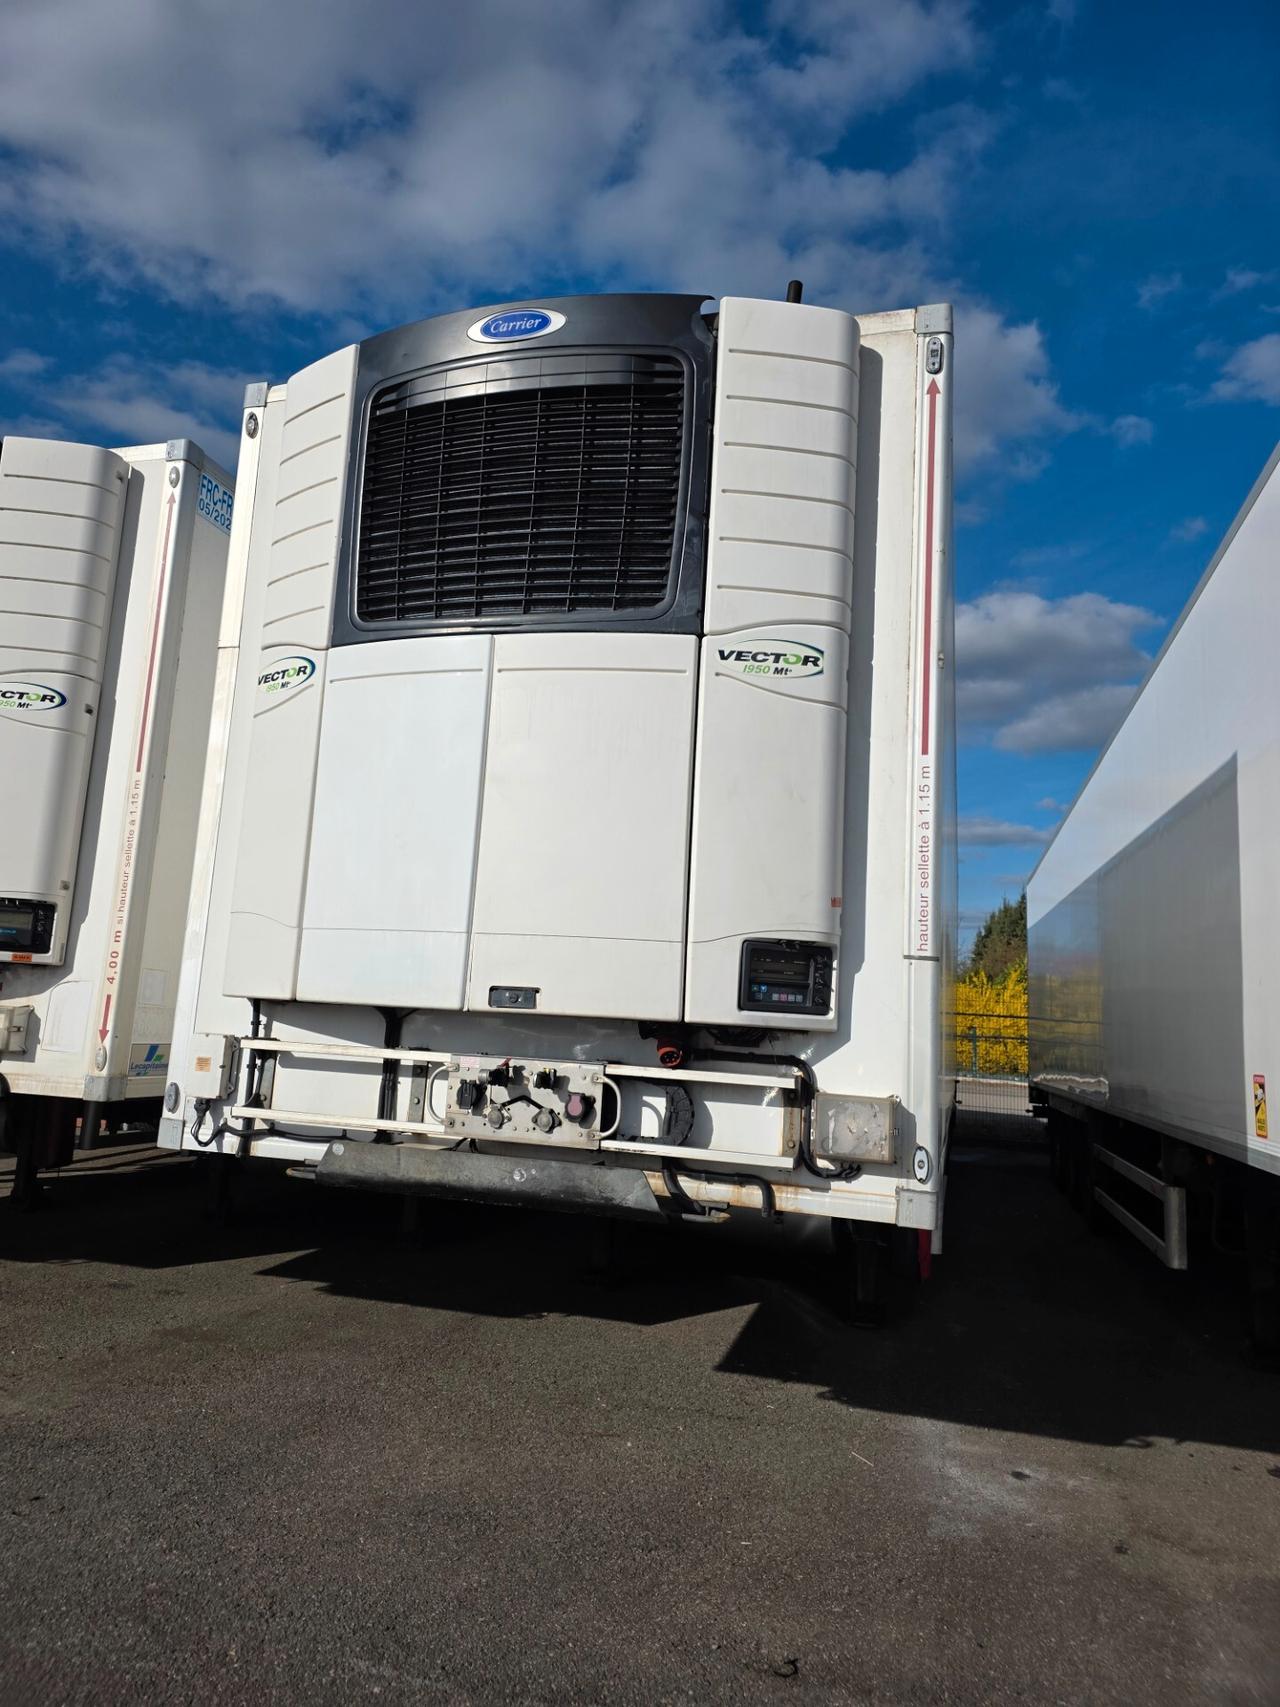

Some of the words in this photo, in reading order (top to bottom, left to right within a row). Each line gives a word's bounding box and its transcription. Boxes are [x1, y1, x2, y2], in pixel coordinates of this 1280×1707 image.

[490, 317, 542, 334] Carrier
[718, 649, 822, 668] VECTOR
[257, 665, 308, 686] VECTOR
[742, 664, 771, 674] 1950
[0, 690, 56, 703] CTOR
[922, 766, 931, 779] m
[918, 784, 930, 815] 1.15
[918, 821, 930, 830] à
[114, 930, 122, 943] m
[118, 871, 129, 912] hauteur
[124, 829, 135, 868] sellette
[135, 779, 142, 790] m
[918, 835, 930, 889] sellette
[917, 894, 929, 952] hauteur
